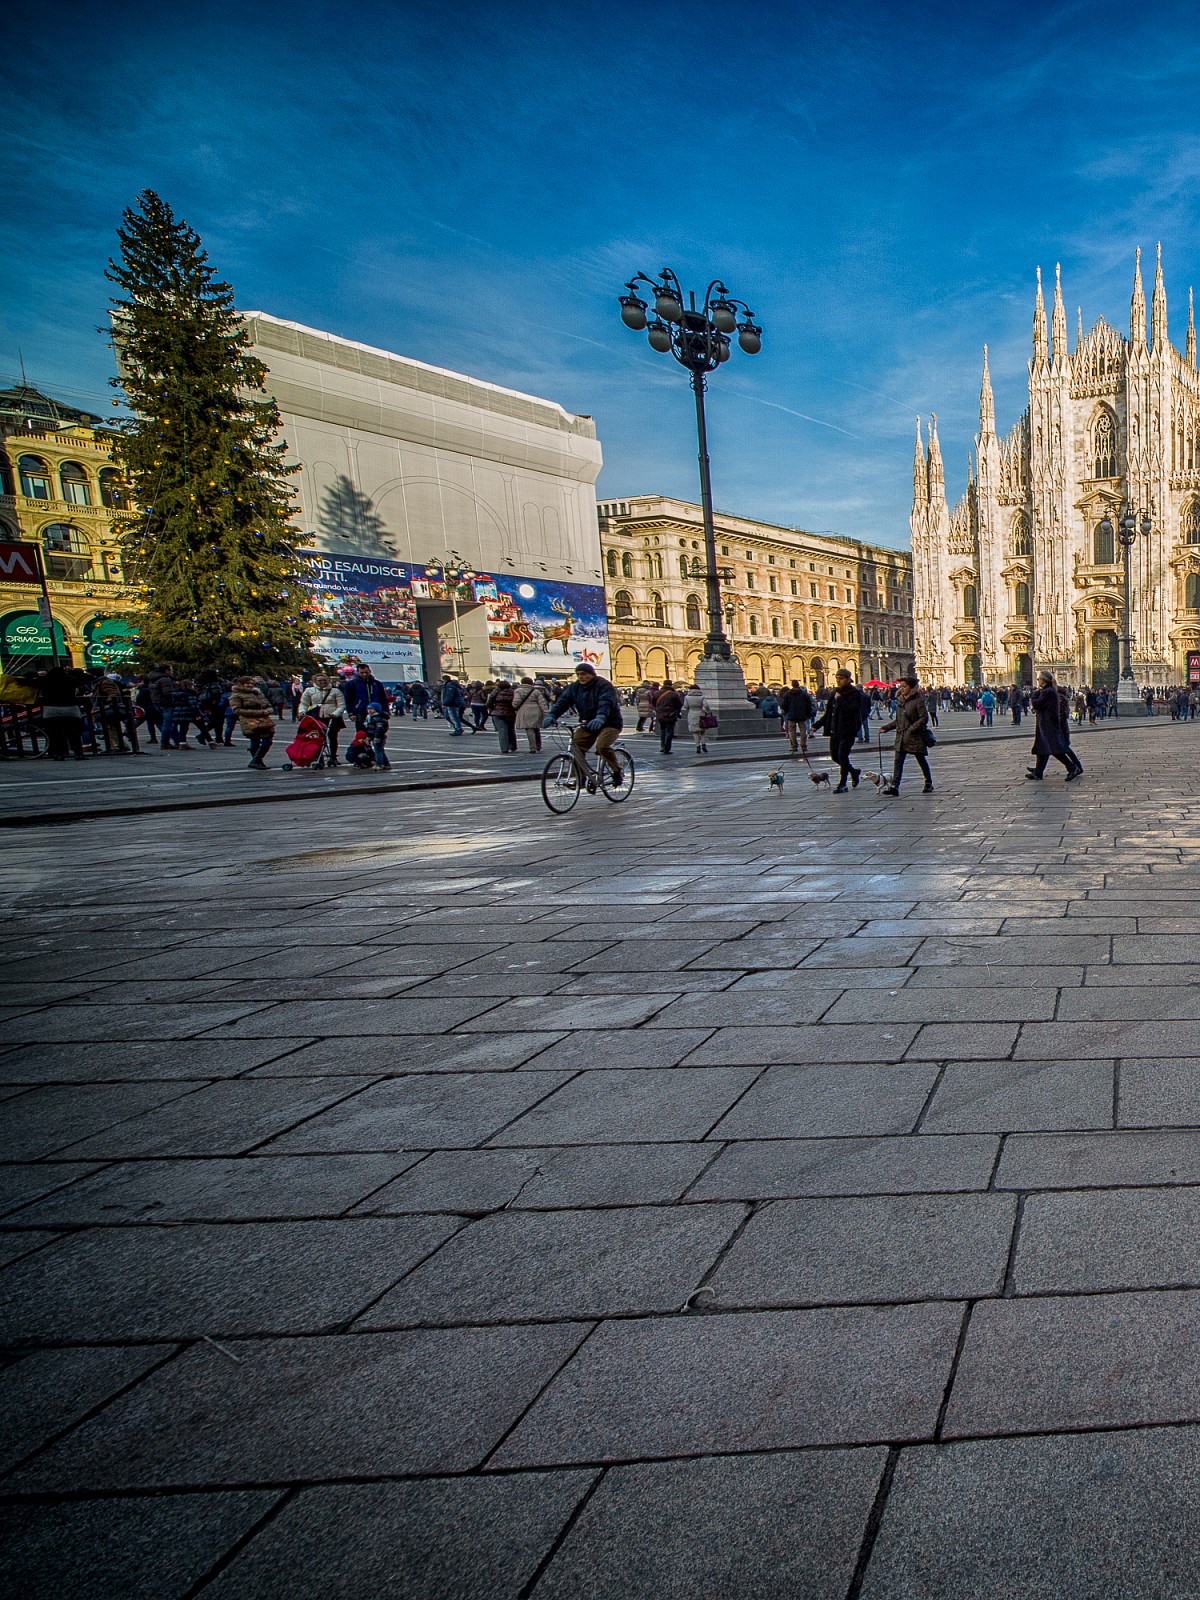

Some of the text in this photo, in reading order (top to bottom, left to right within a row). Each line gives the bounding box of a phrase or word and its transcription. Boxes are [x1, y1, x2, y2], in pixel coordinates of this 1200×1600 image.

[334, 561, 406, 578] ESAUDISCE
[5, 635, 51, 644] GRIMOLD
[572, 647, 604, 667] sky
[1190, 658, 1200, 666] M
